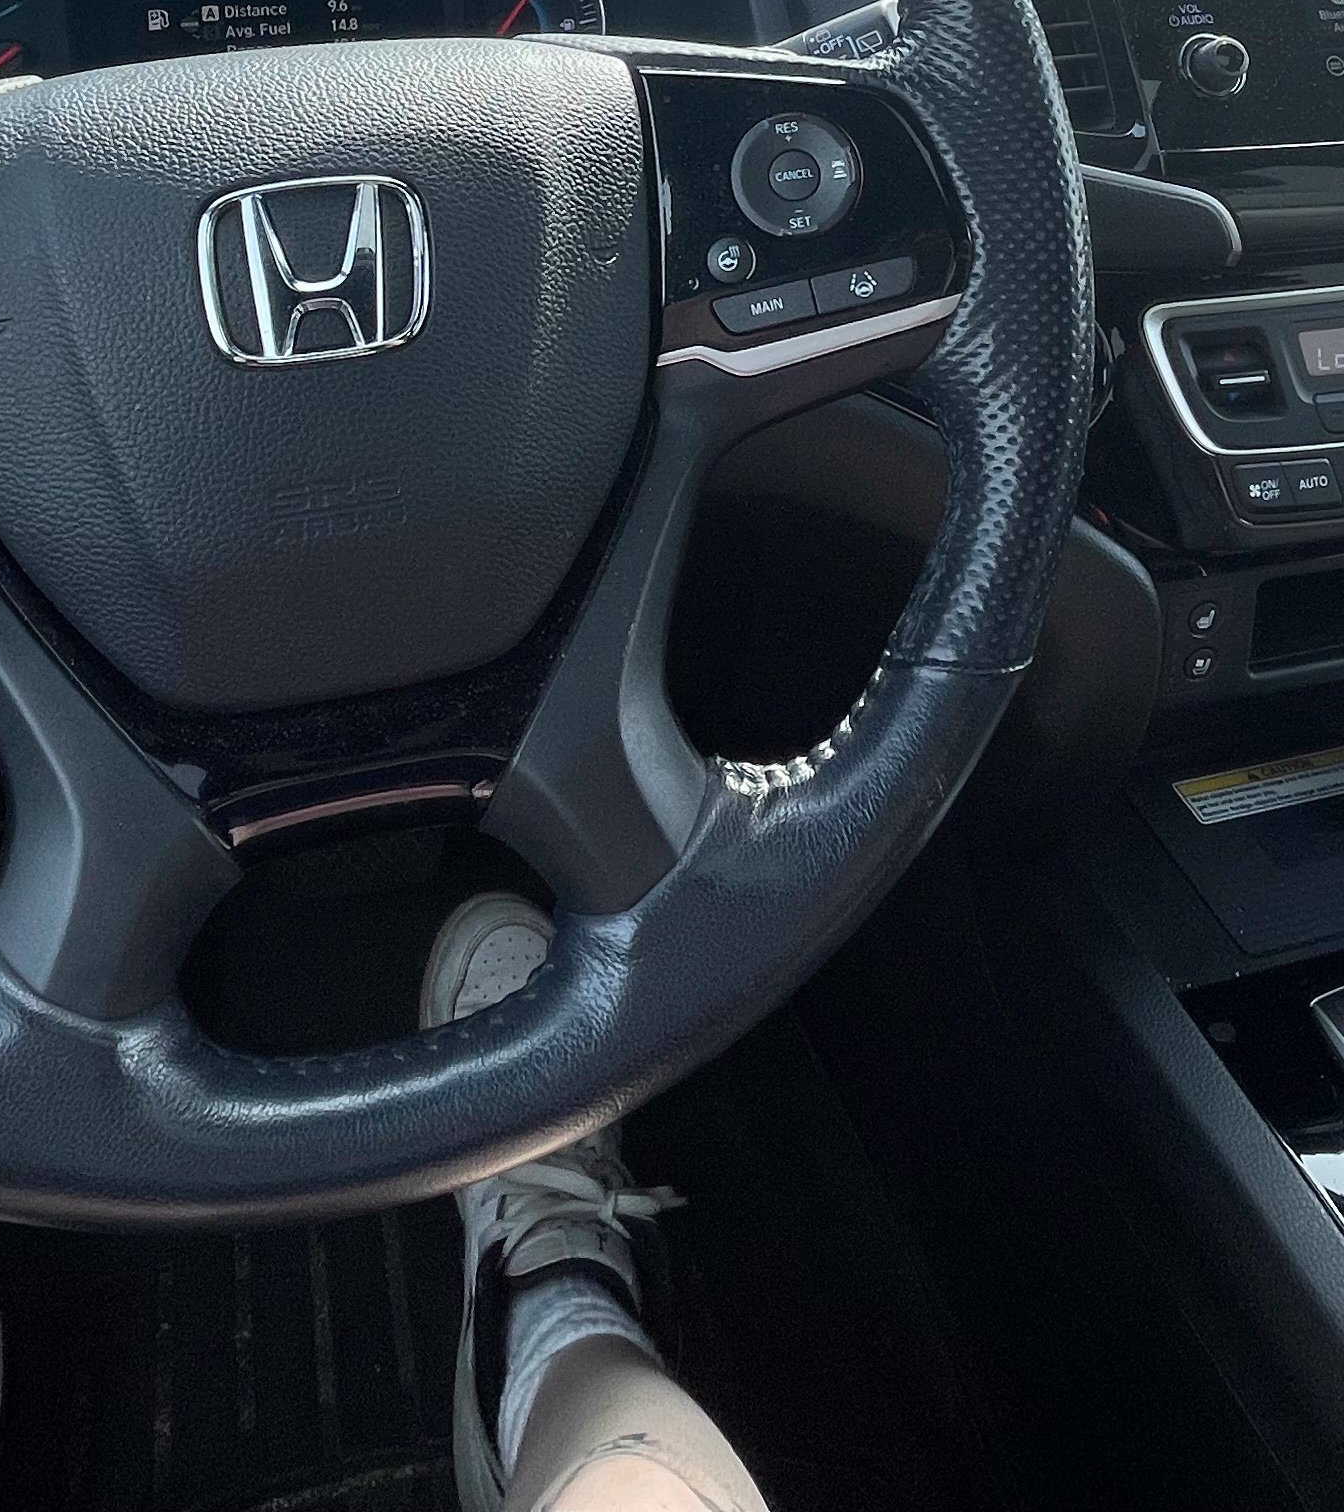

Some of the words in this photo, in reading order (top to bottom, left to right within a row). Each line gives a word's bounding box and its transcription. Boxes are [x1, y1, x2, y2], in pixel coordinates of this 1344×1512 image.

[224, 3, 287, 19] Distance
[327, 0, 349, 13] 9.6
[1178, 4, 1202, 14] VOL
[1181, 14, 1215, 26] AUDIO
[225, 25, 255, 39] Avg.
[259, 21, 291, 36] Fuel
[330, 18, 359, 33] 14.8
[775, 121, 799, 134] RES
[775, 168, 814, 182] CANCEL
[789, 215, 812, 229] SET
[750, 297, 784, 316] MAIN
[1298, 475, 1329, 490] AUTO
[1262, 489, 1282, 501] OFF
